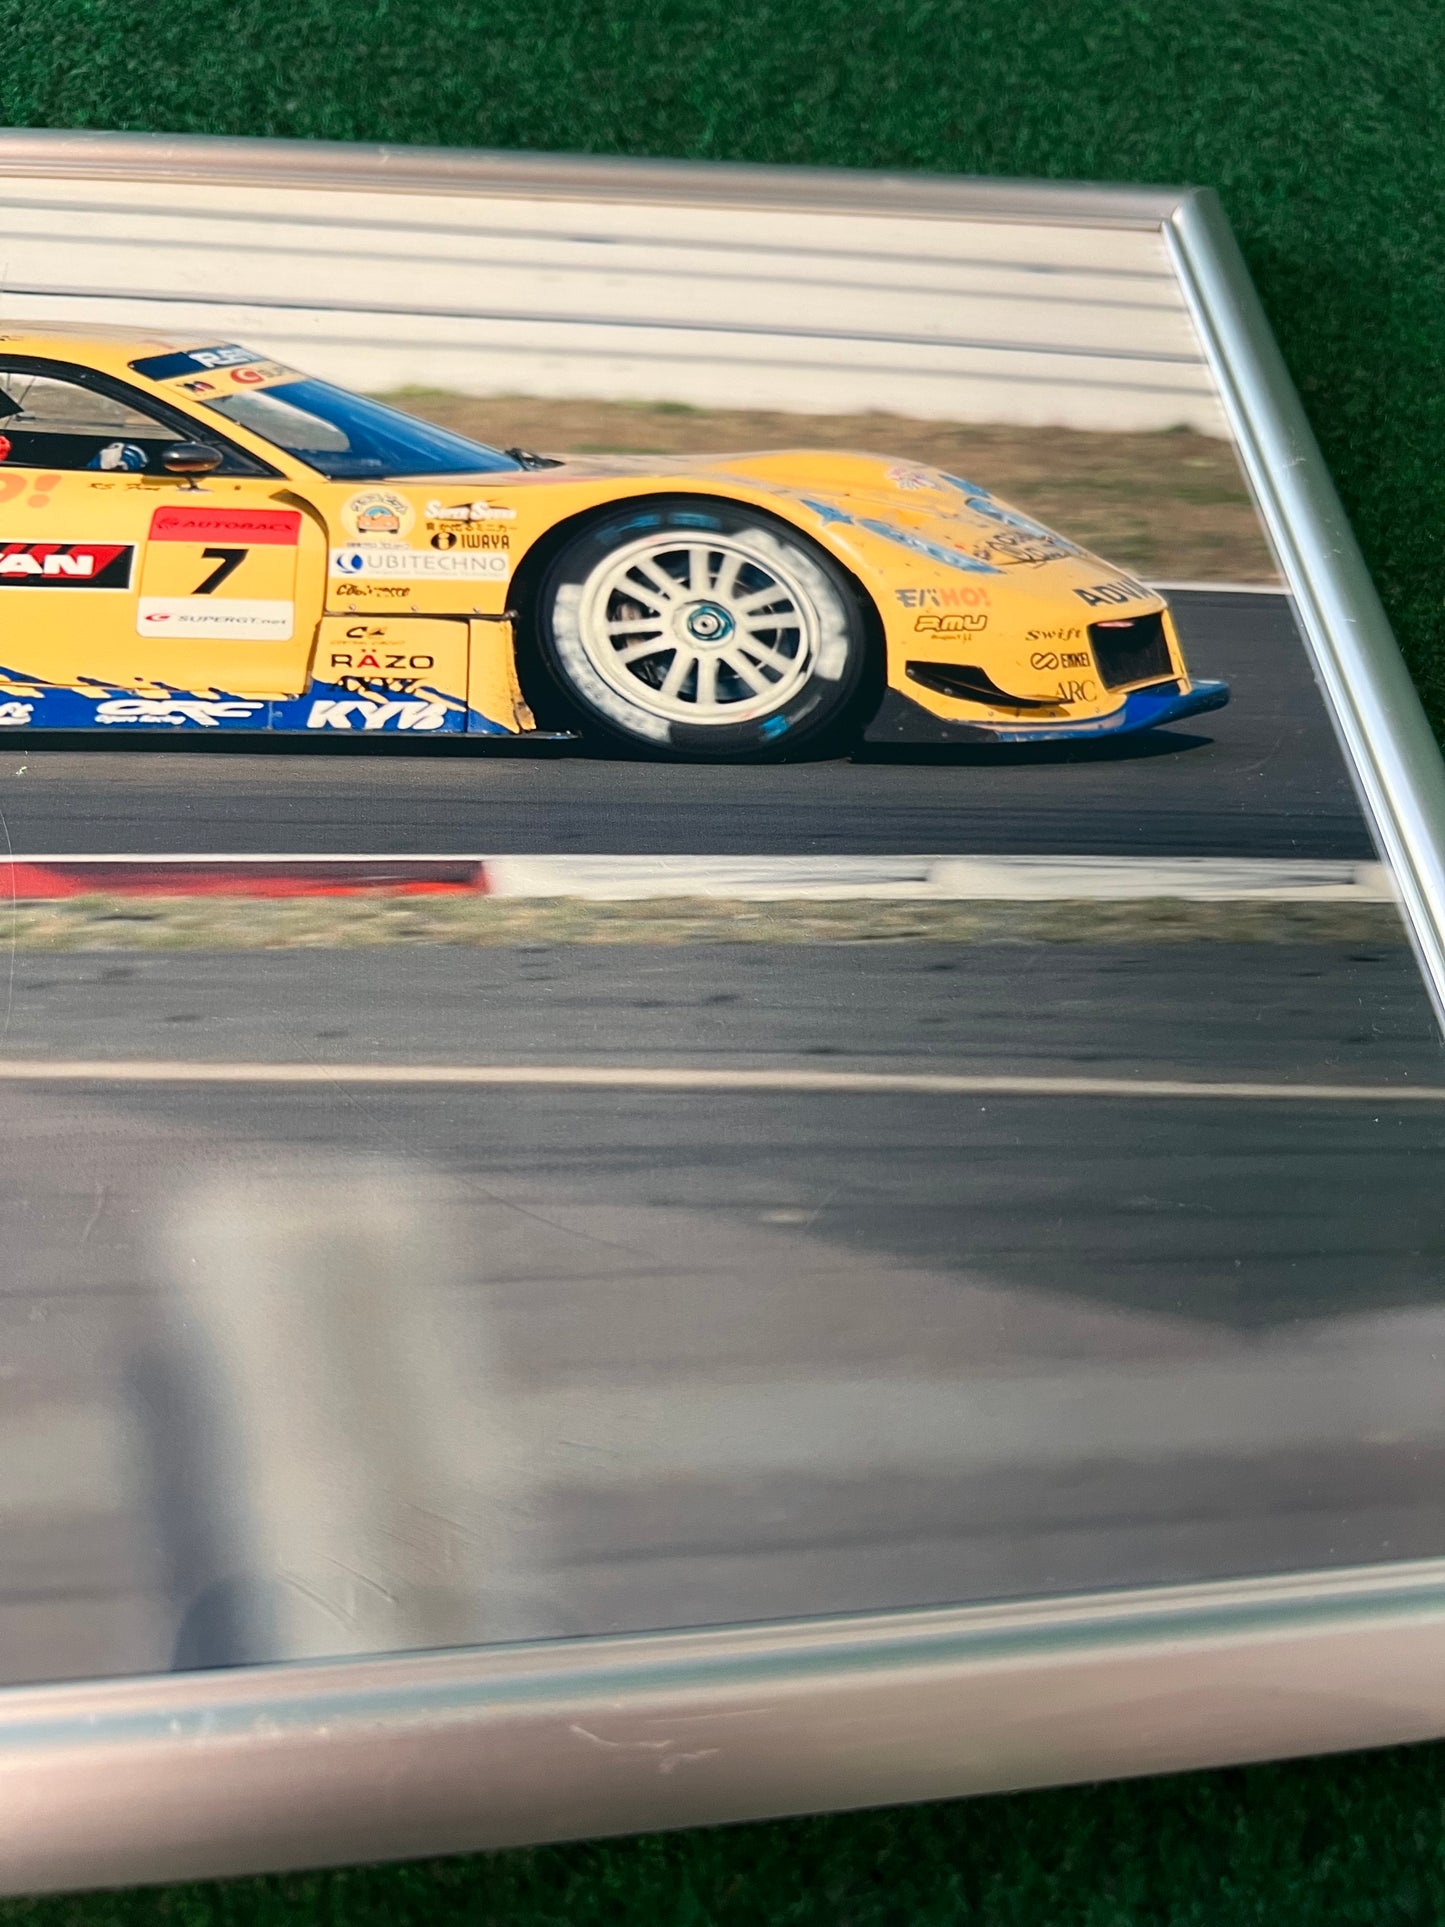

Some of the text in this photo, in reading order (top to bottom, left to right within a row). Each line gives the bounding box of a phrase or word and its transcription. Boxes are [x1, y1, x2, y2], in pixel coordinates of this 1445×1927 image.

[461, 533, 510, 549] IWAYA
[190, 547, 250, 594] 7
[367, 554, 507, 572] UBITECHNO
[1024, 627, 1081, 641] Swift
[1055, 680, 1098, 702] ARC
[306, 700, 448, 730] KYB
